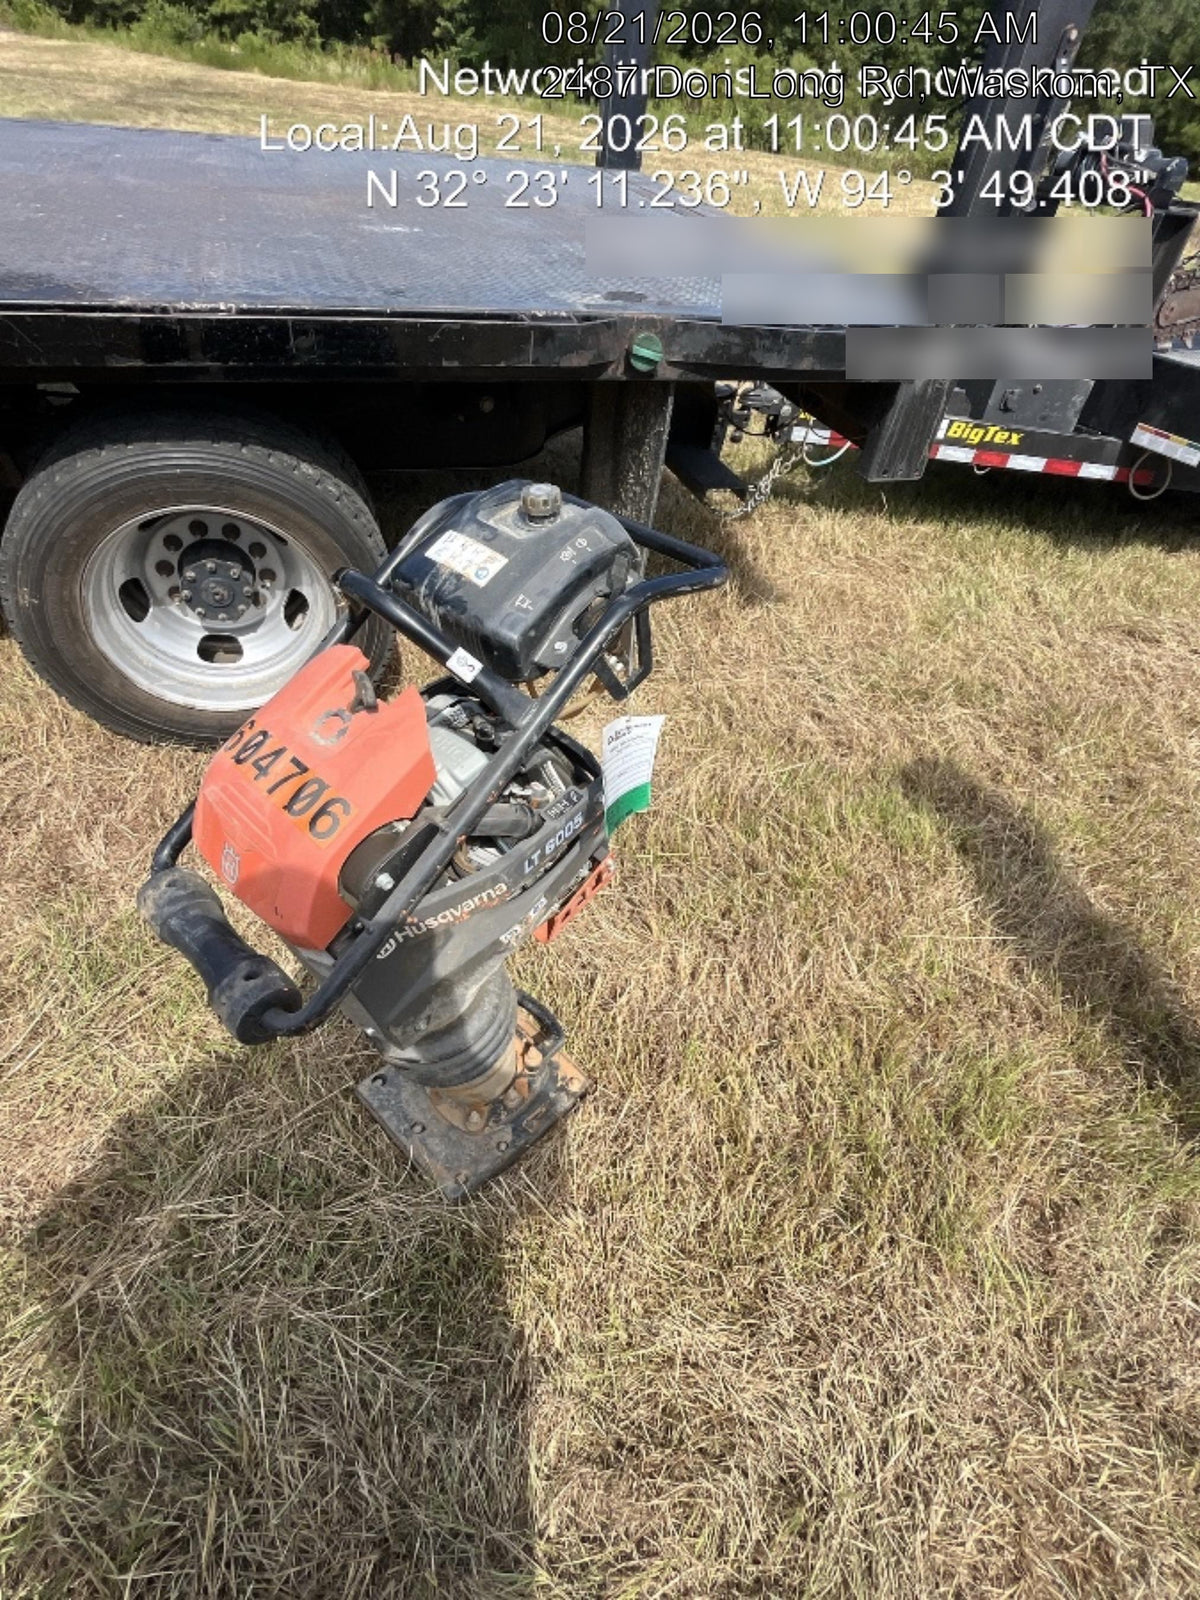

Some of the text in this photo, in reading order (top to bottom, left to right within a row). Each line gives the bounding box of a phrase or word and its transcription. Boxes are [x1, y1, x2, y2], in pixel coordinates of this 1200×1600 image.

[947, 420, 1024, 446] BigTex
[523, 811, 584, 875] LT 6005
[395, 881, 508, 943] Husqvarna
